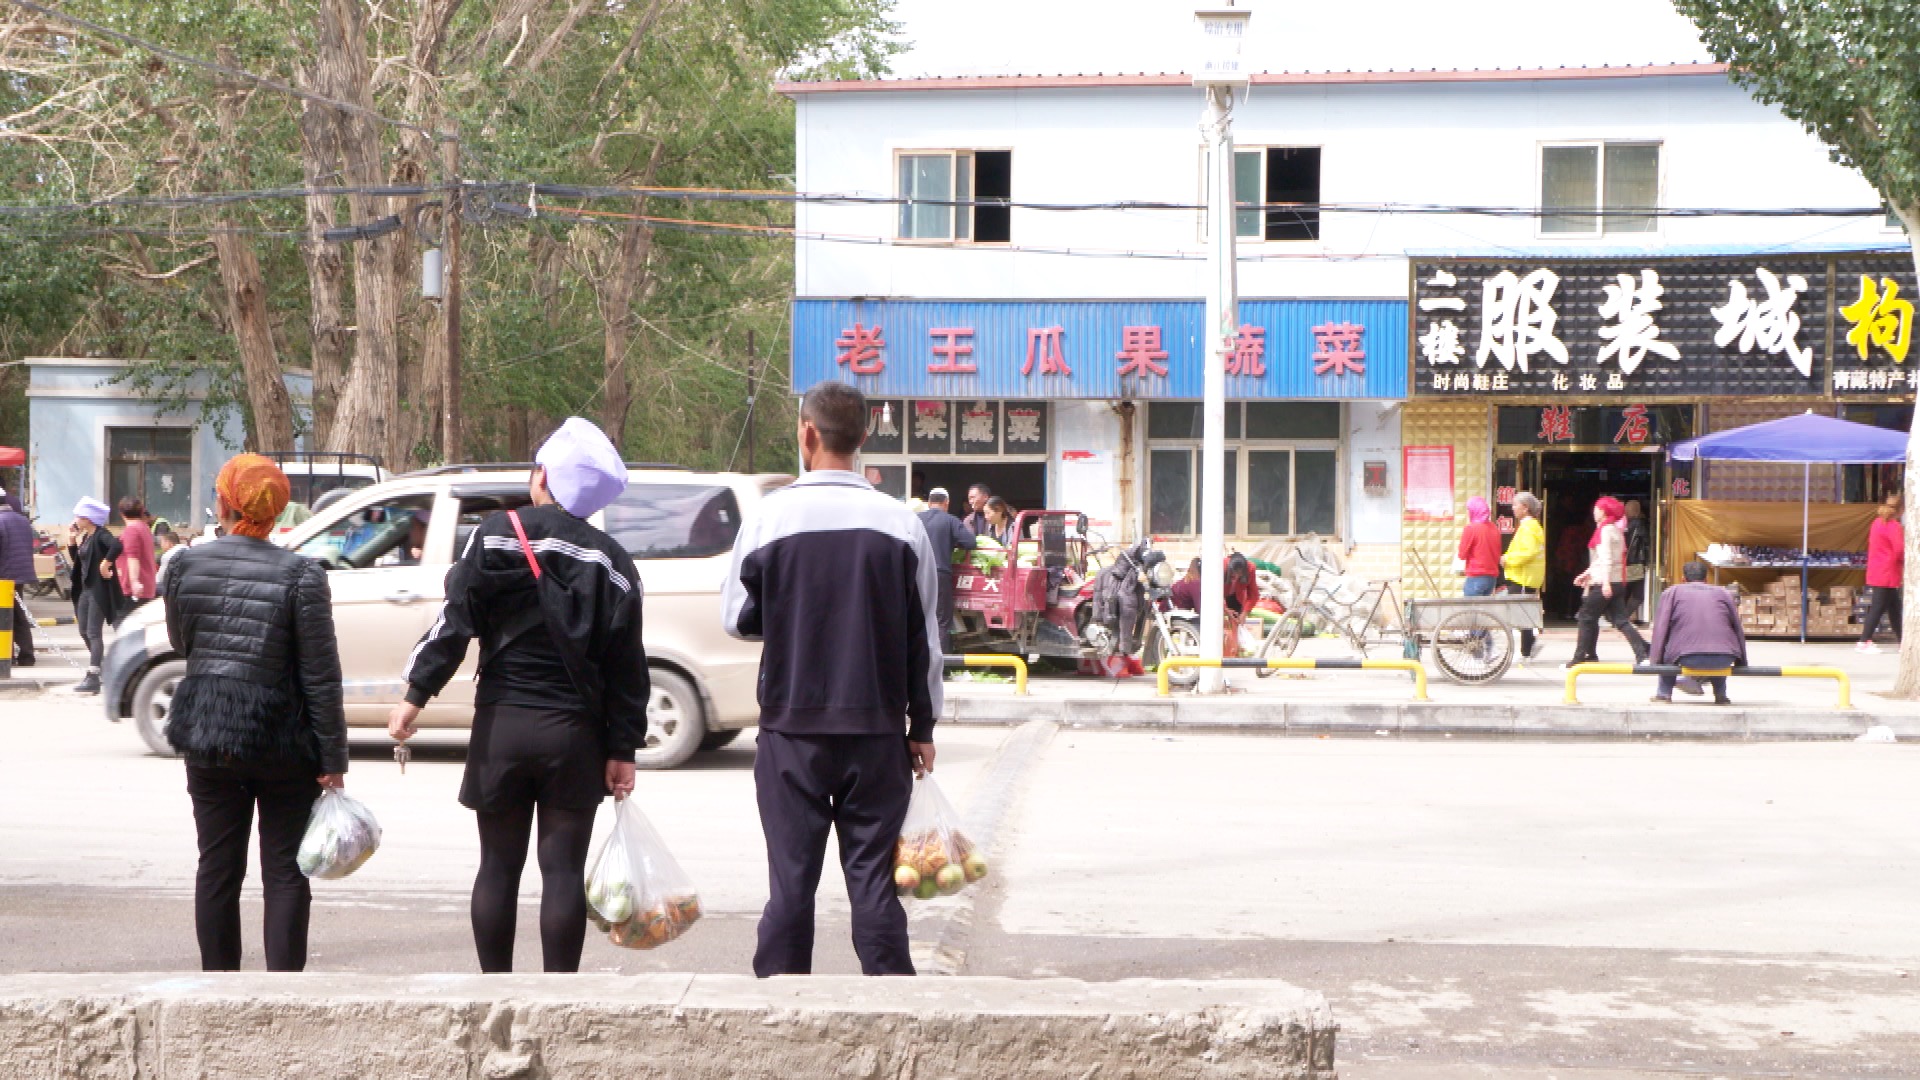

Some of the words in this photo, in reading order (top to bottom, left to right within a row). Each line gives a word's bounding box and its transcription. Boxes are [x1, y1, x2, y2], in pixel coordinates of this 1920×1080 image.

[1419, 270, 1466, 366] 二楼
[1476, 267, 1813, 378] 服装城
[836, 322, 1366, 377] 老王瓜果蔬菜
[1434, 374, 1509, 390] 时尚鞋庄
[1553, 374, 1624, 390] 化妆品
[1538, 404, 1650, 443] 鞋店
